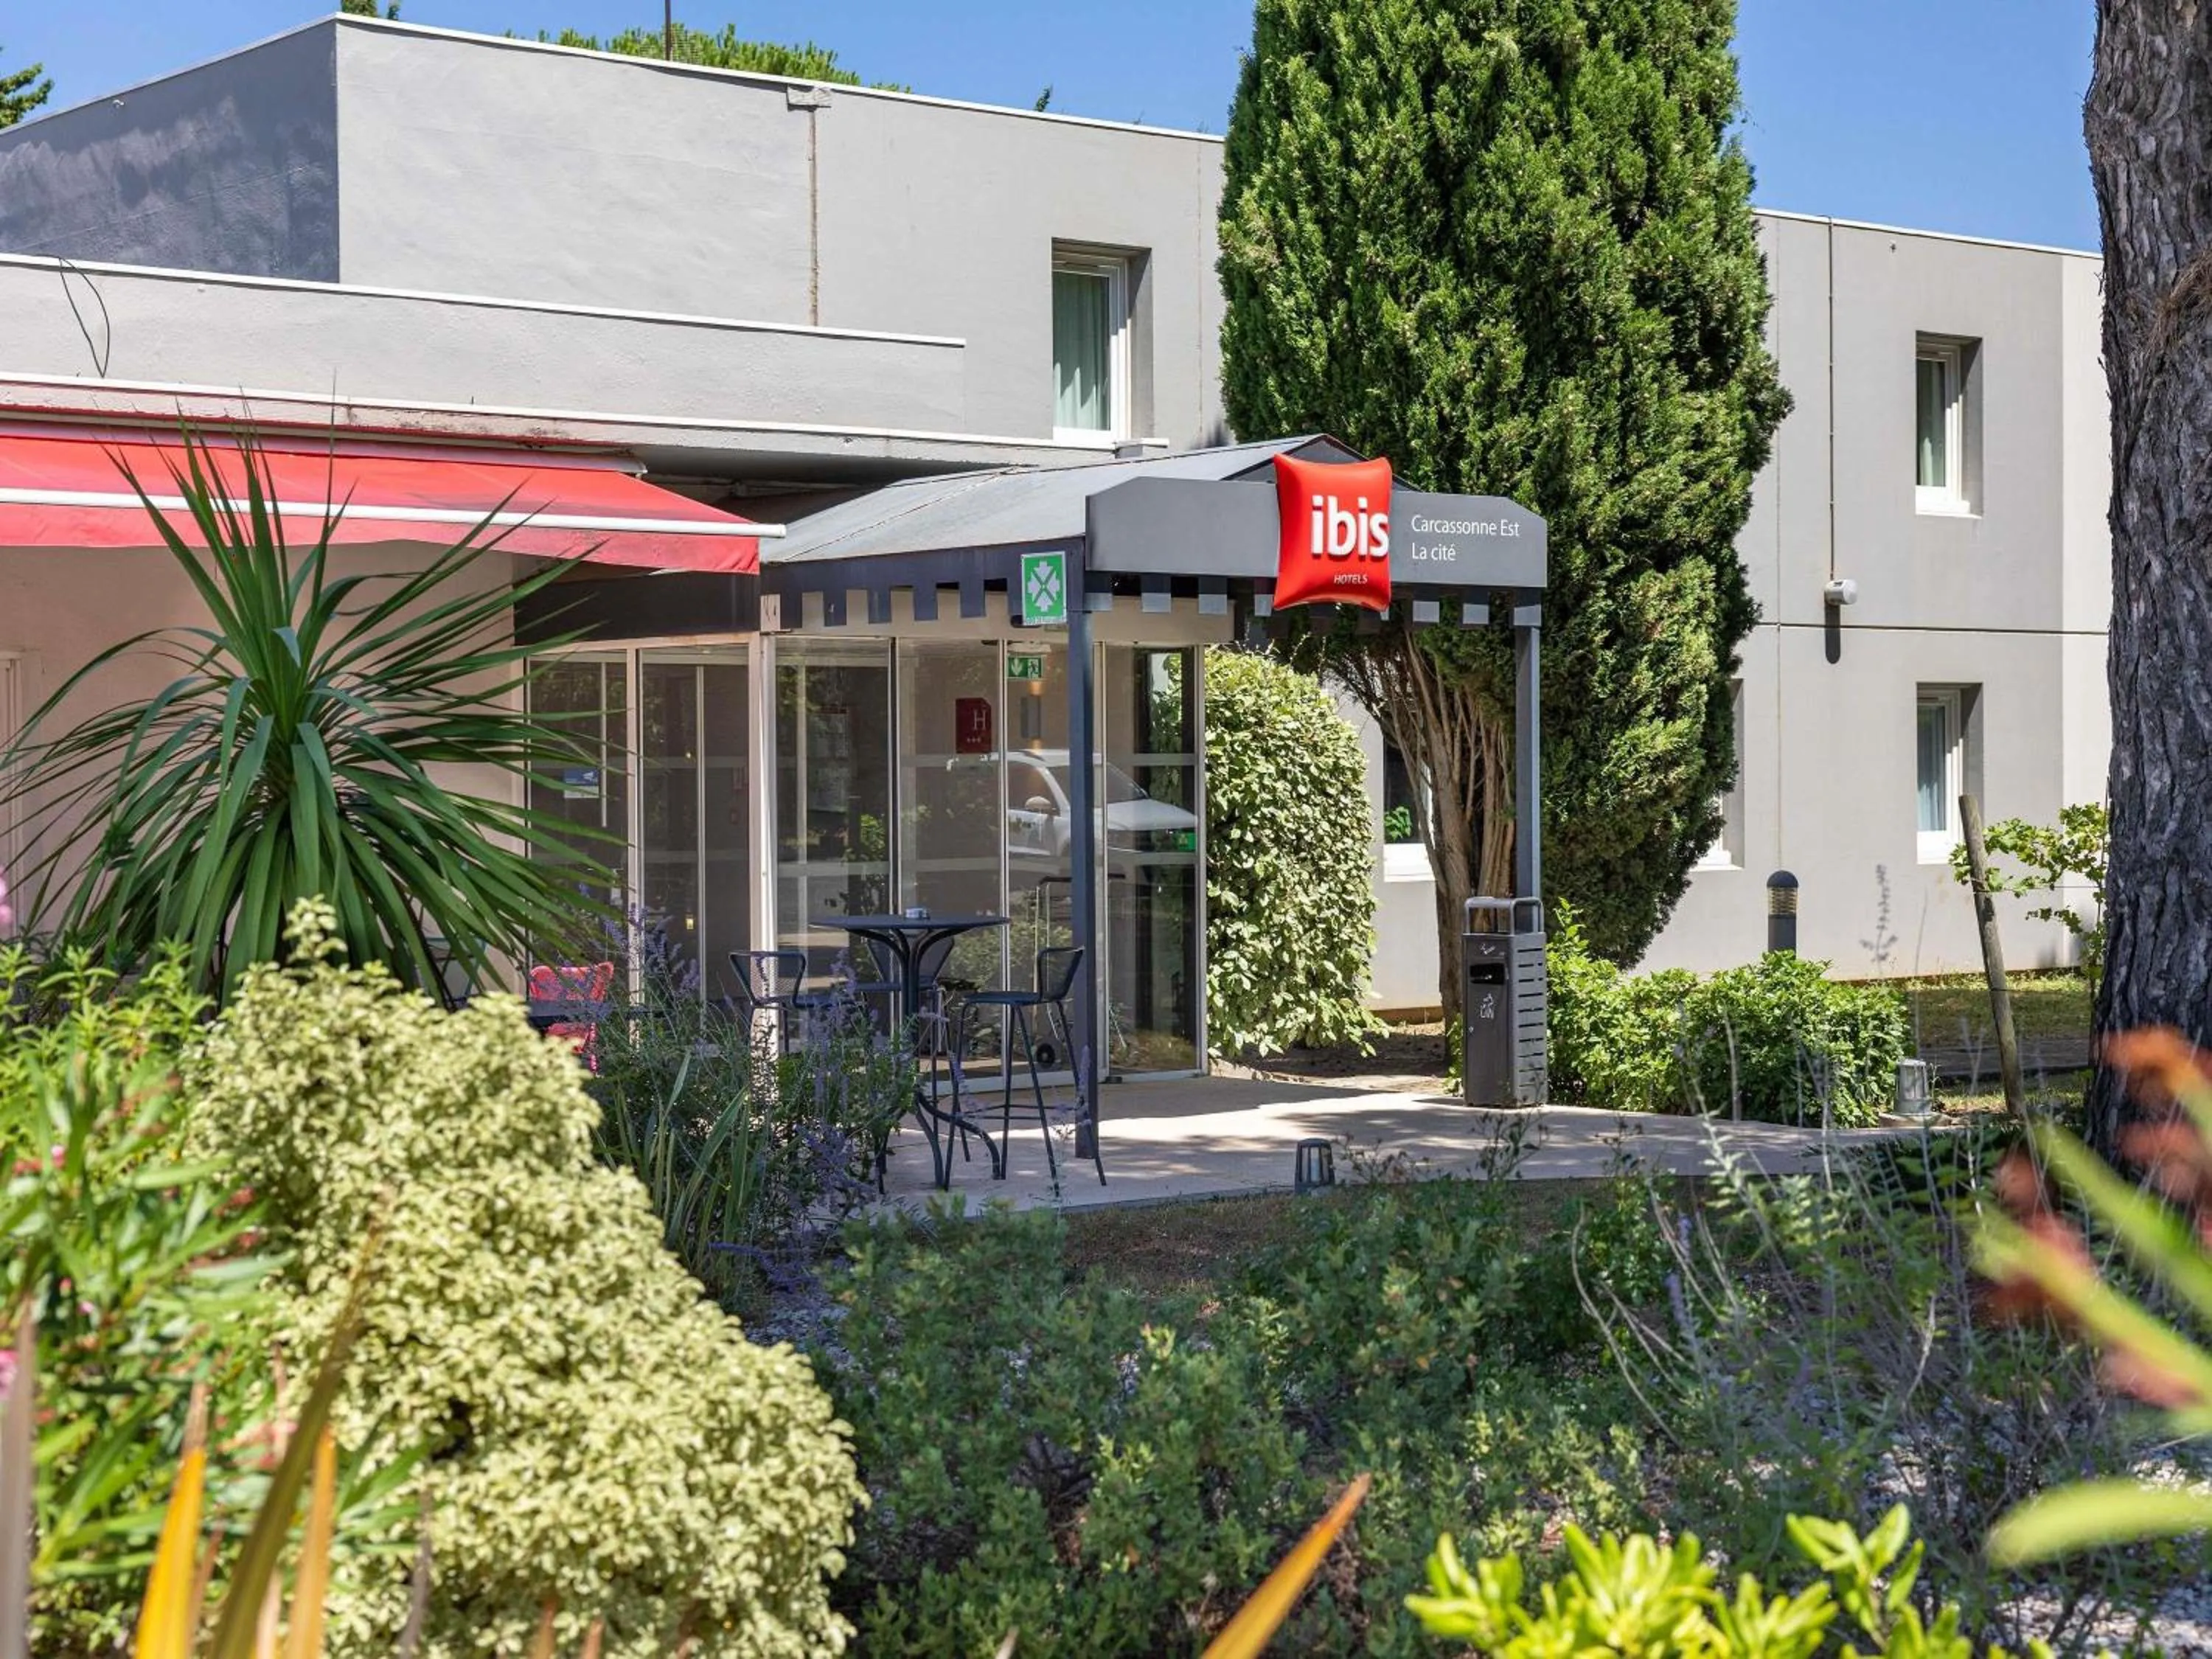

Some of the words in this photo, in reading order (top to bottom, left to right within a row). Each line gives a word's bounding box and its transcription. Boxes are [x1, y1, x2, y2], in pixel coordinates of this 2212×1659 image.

[1311, 495, 1389, 557] ibis
[1411, 515, 1497, 535] Carcassonne
[1500, 518, 1520, 537] Est
[1412, 542, 1427, 560] La
[1431, 543, 1456, 561] cité
[1334, 574, 1368, 585] HOTELS
[973, 709, 987, 731] H
